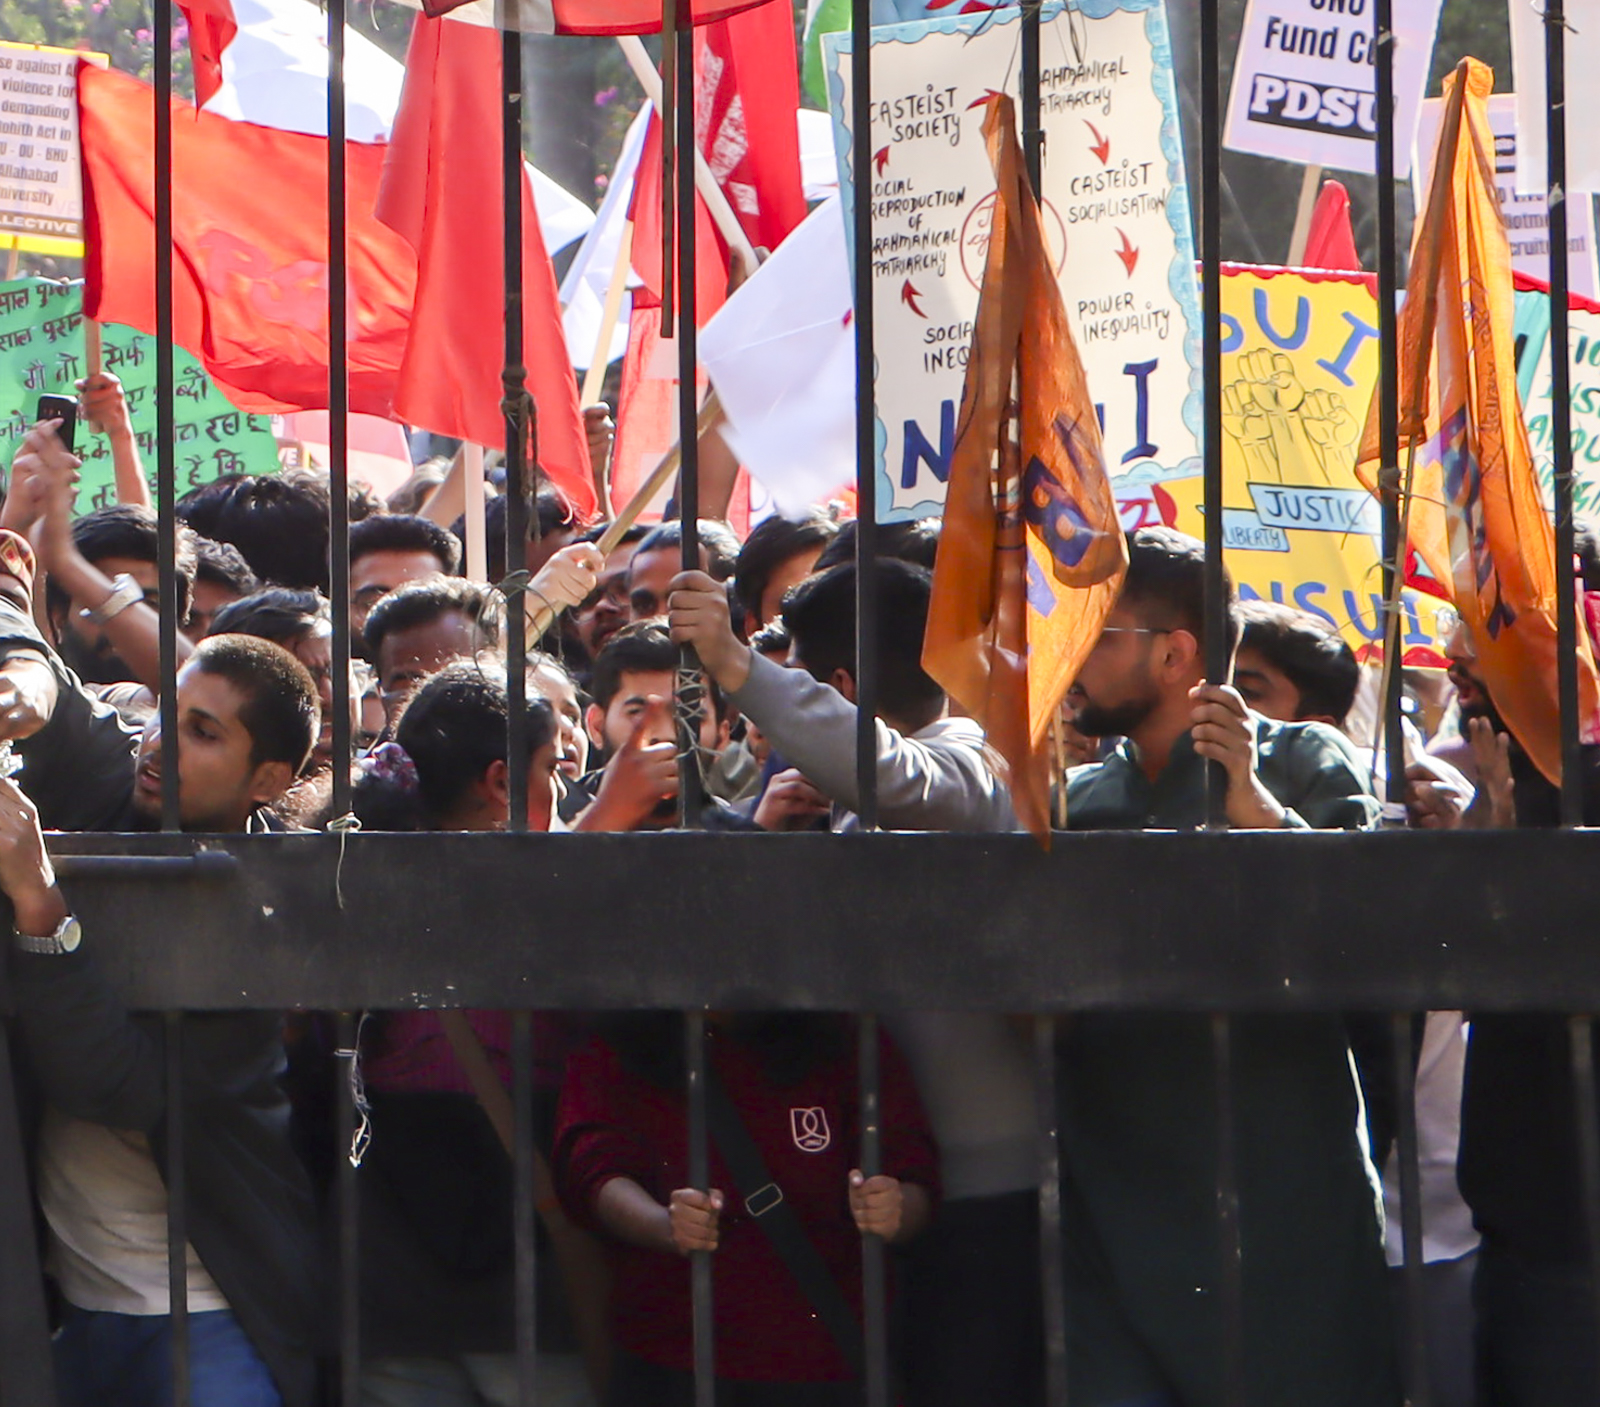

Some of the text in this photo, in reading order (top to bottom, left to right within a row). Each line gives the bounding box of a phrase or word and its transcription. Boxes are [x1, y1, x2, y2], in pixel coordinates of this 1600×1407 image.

[1264, 15, 1339, 60] Fund
[16, 58, 62, 77] against
[2, 76, 54, 97] violence
[1, 98, 70, 120] demanding
[36, 124, 56, 139] Act
[60, 128, 72, 142] in
[892, 113, 961, 147] SOCIETY
[908, 212, 925, 232] OF
[1078, 291, 1135, 321] POWER
[1223, 524, 1282, 549] LIBERTY
